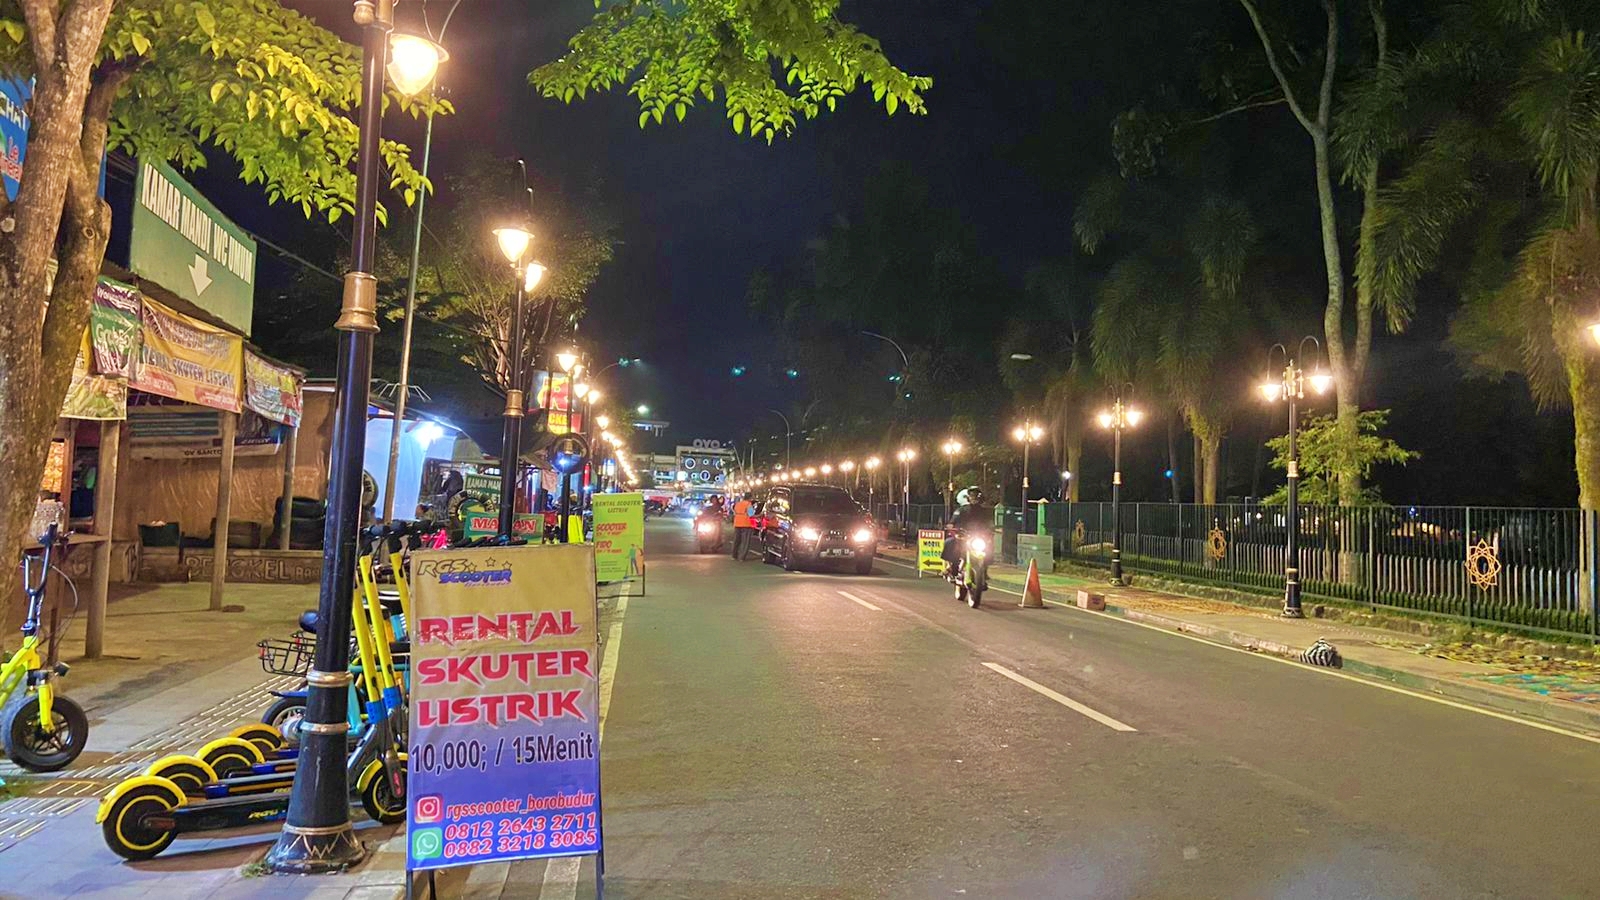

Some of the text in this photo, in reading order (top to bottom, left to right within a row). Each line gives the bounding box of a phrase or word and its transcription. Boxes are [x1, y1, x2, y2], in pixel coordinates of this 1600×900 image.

[141, 162, 253, 285] KAMAR MANDI WC UMUM
[471, 518, 536, 532] MAAN
[417, 559, 468, 578] RGS
[439, 570, 512, 584] SCOOTER
[418, 610, 582, 647] RENTAL
[416, 650, 596, 687] SKUTER
[417, 689, 588, 729] LISTRIK
[411, 740, 487, 775] 10,000;
[512, 731, 594, 764] 15Menit
[446, 790, 595, 821] rgsscooter_borobudur
[445, 811, 597, 841] 0812 2643 2711
[443, 828, 597, 859] 0882 3218 3085
